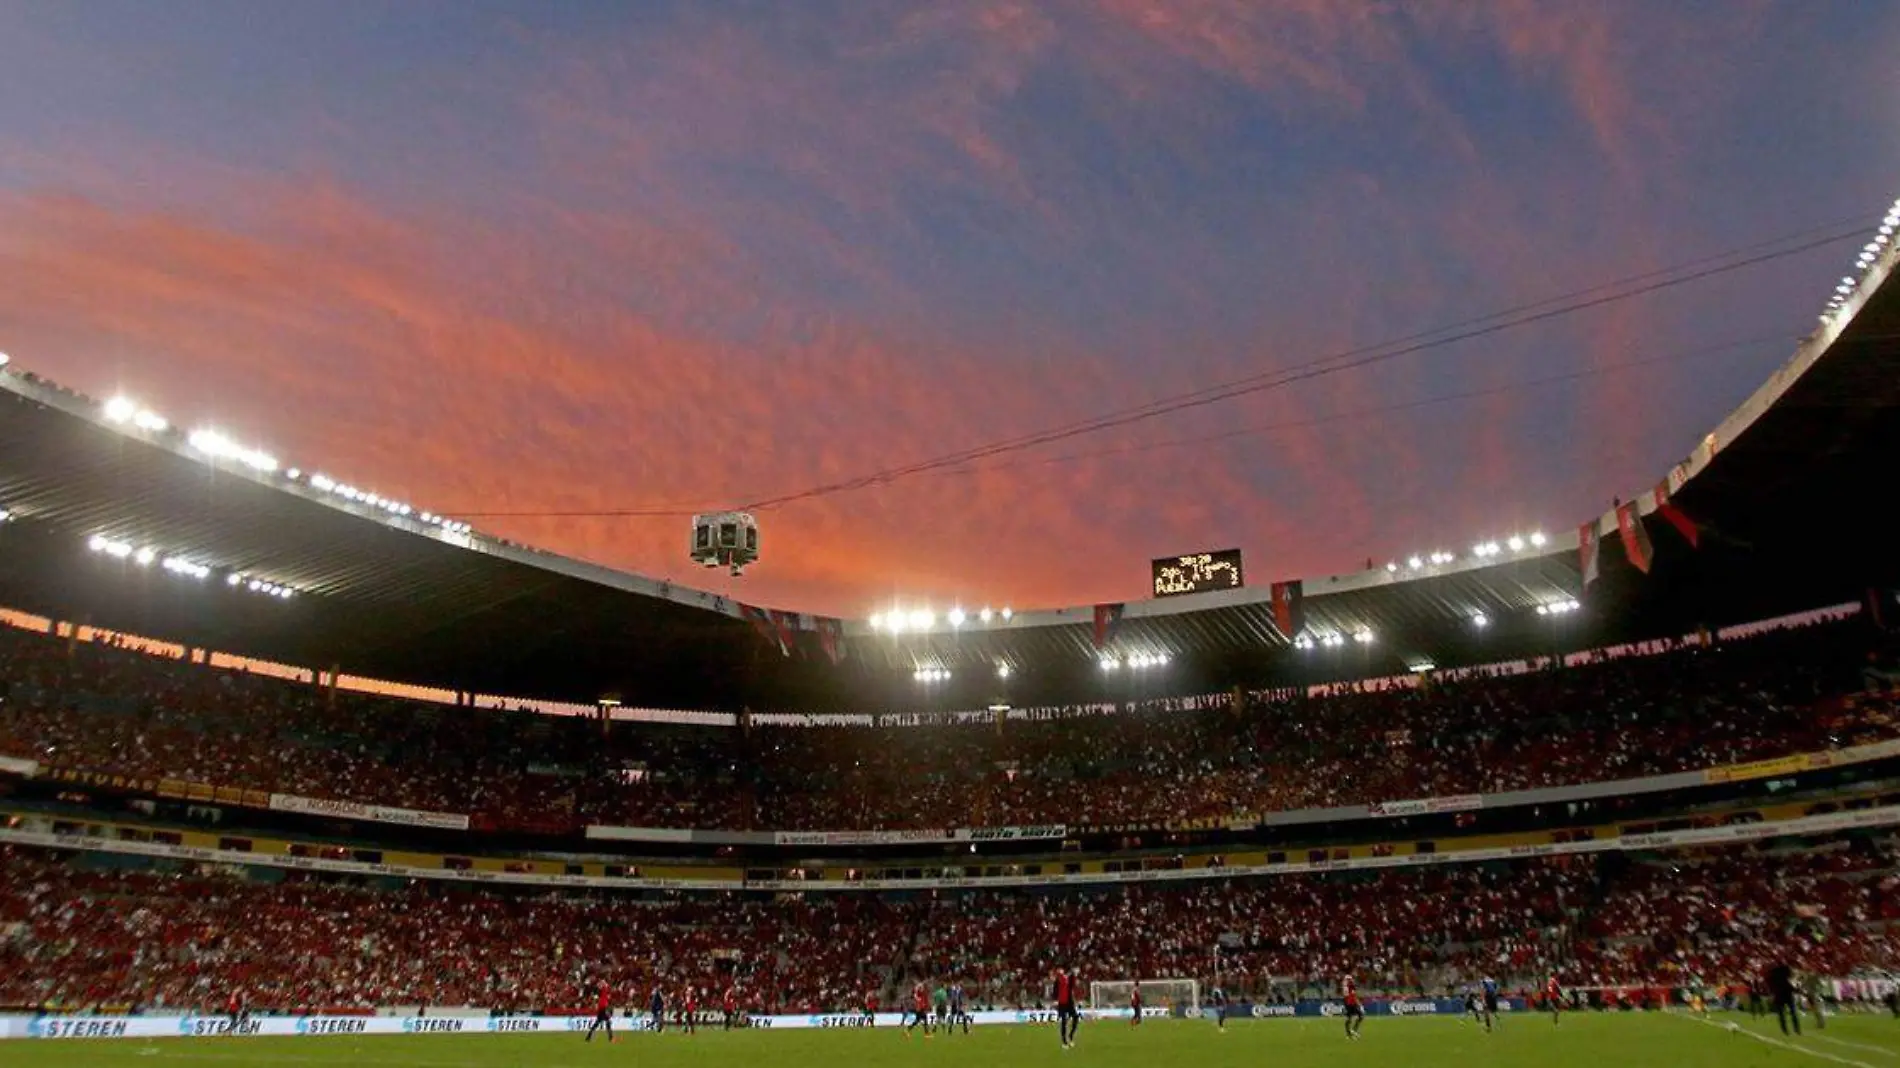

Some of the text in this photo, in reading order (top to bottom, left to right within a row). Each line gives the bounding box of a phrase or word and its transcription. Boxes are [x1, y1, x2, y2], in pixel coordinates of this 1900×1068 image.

[1251, 1004, 1295, 1018] Corona
[1390, 1000, 1437, 1015] Corona
[48, 1019, 128, 1037] STEREN
[310, 1019, 367, 1033] STEREN
[415, 1018, 463, 1031] STEREN
[498, 1019, 541, 1031] STEREN
